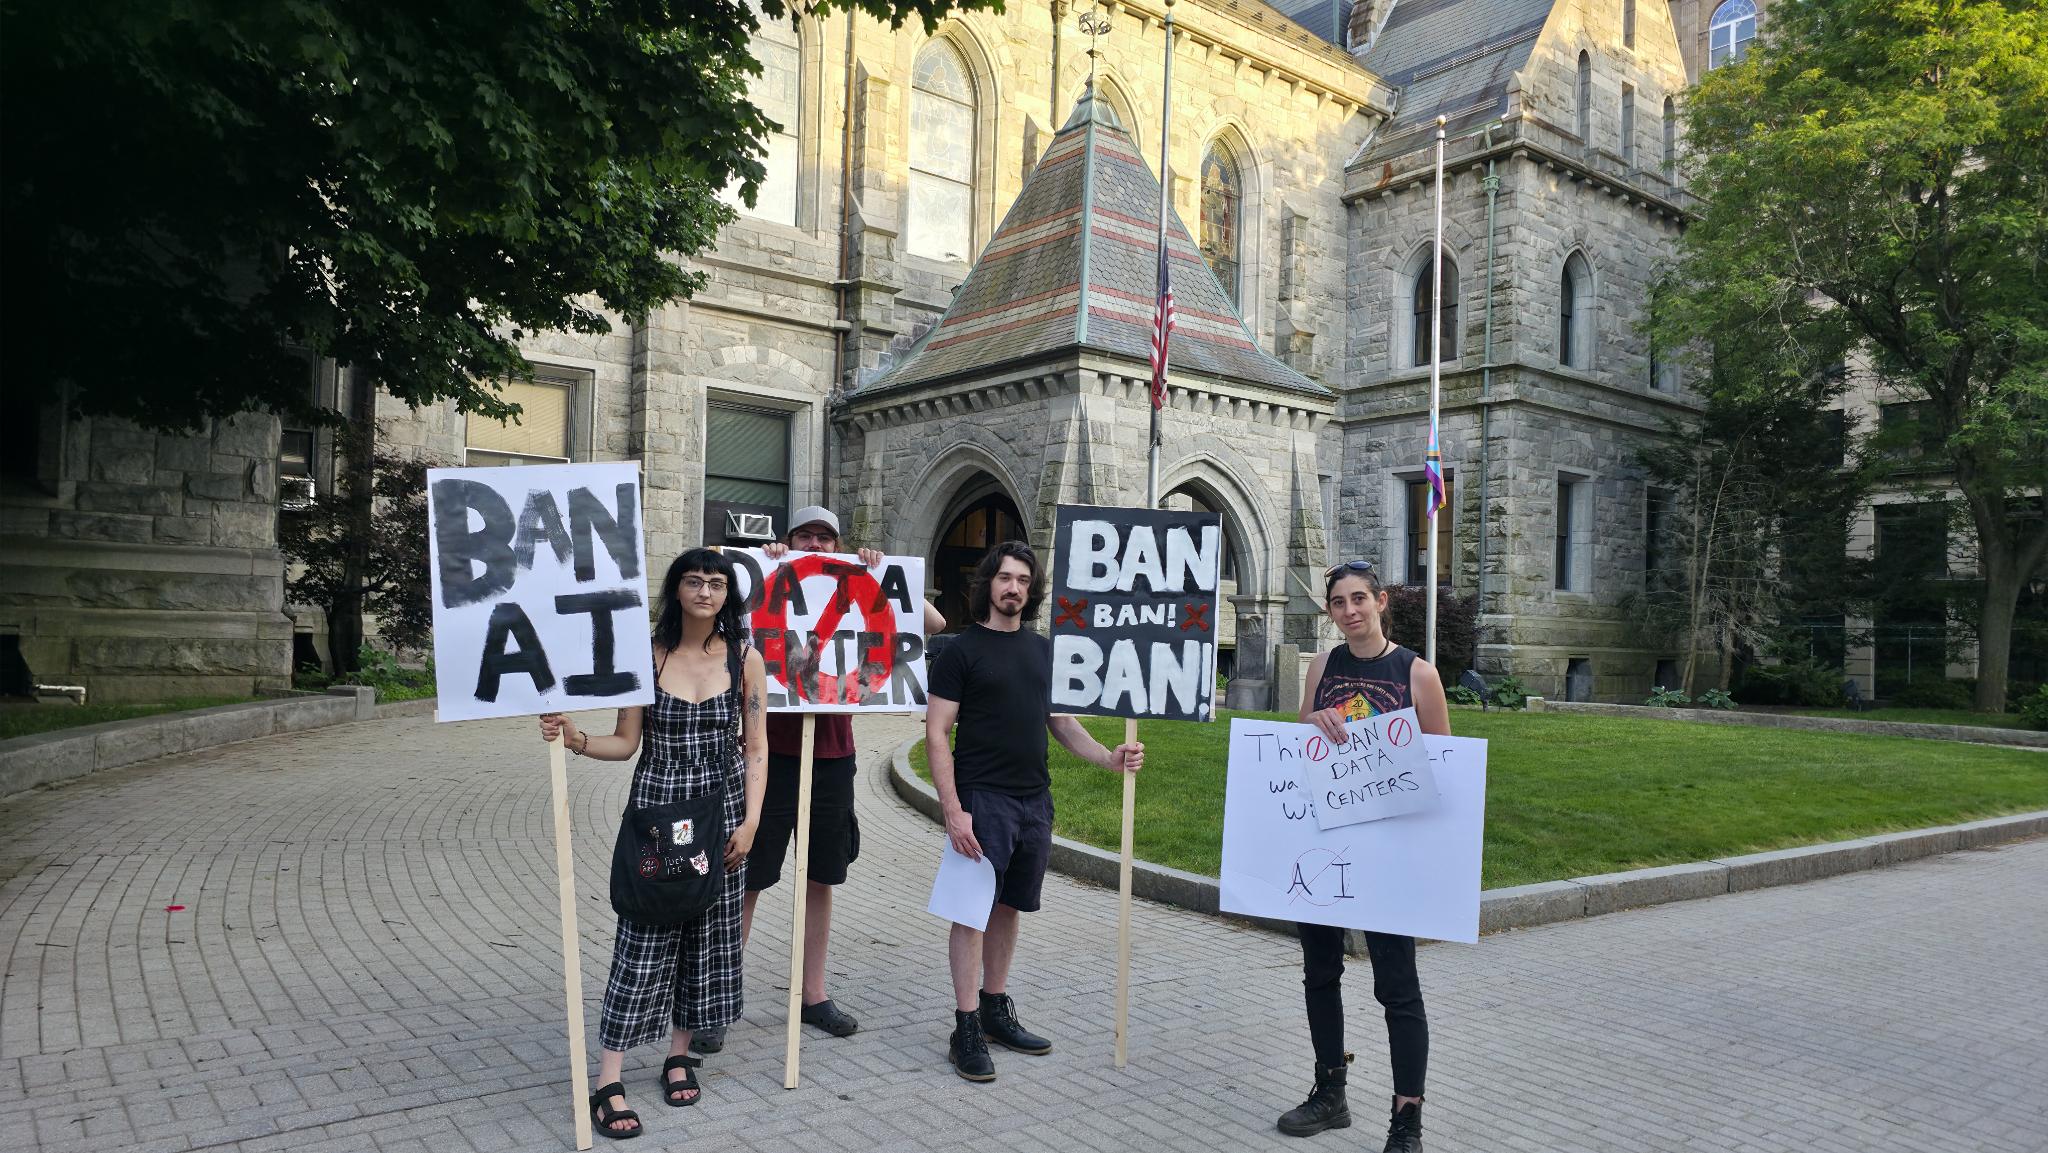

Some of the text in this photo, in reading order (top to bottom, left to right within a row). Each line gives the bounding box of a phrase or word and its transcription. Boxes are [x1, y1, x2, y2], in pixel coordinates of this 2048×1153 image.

[432, 478, 640, 608] BAN
[1067, 519, 1220, 593] BAN
[1093, 603, 1177, 628] BAN!
[474, 588, 642, 703] AI
[738, 627, 929, 707] ENTER
[1051, 634, 1213, 719] BAN!
[1352, 699, 1363, 708] 20
[1331, 749, 1392, 779] DATA
[1336, 722, 1381, 755] BAN
[1326, 771, 1420, 810] CENTERS
